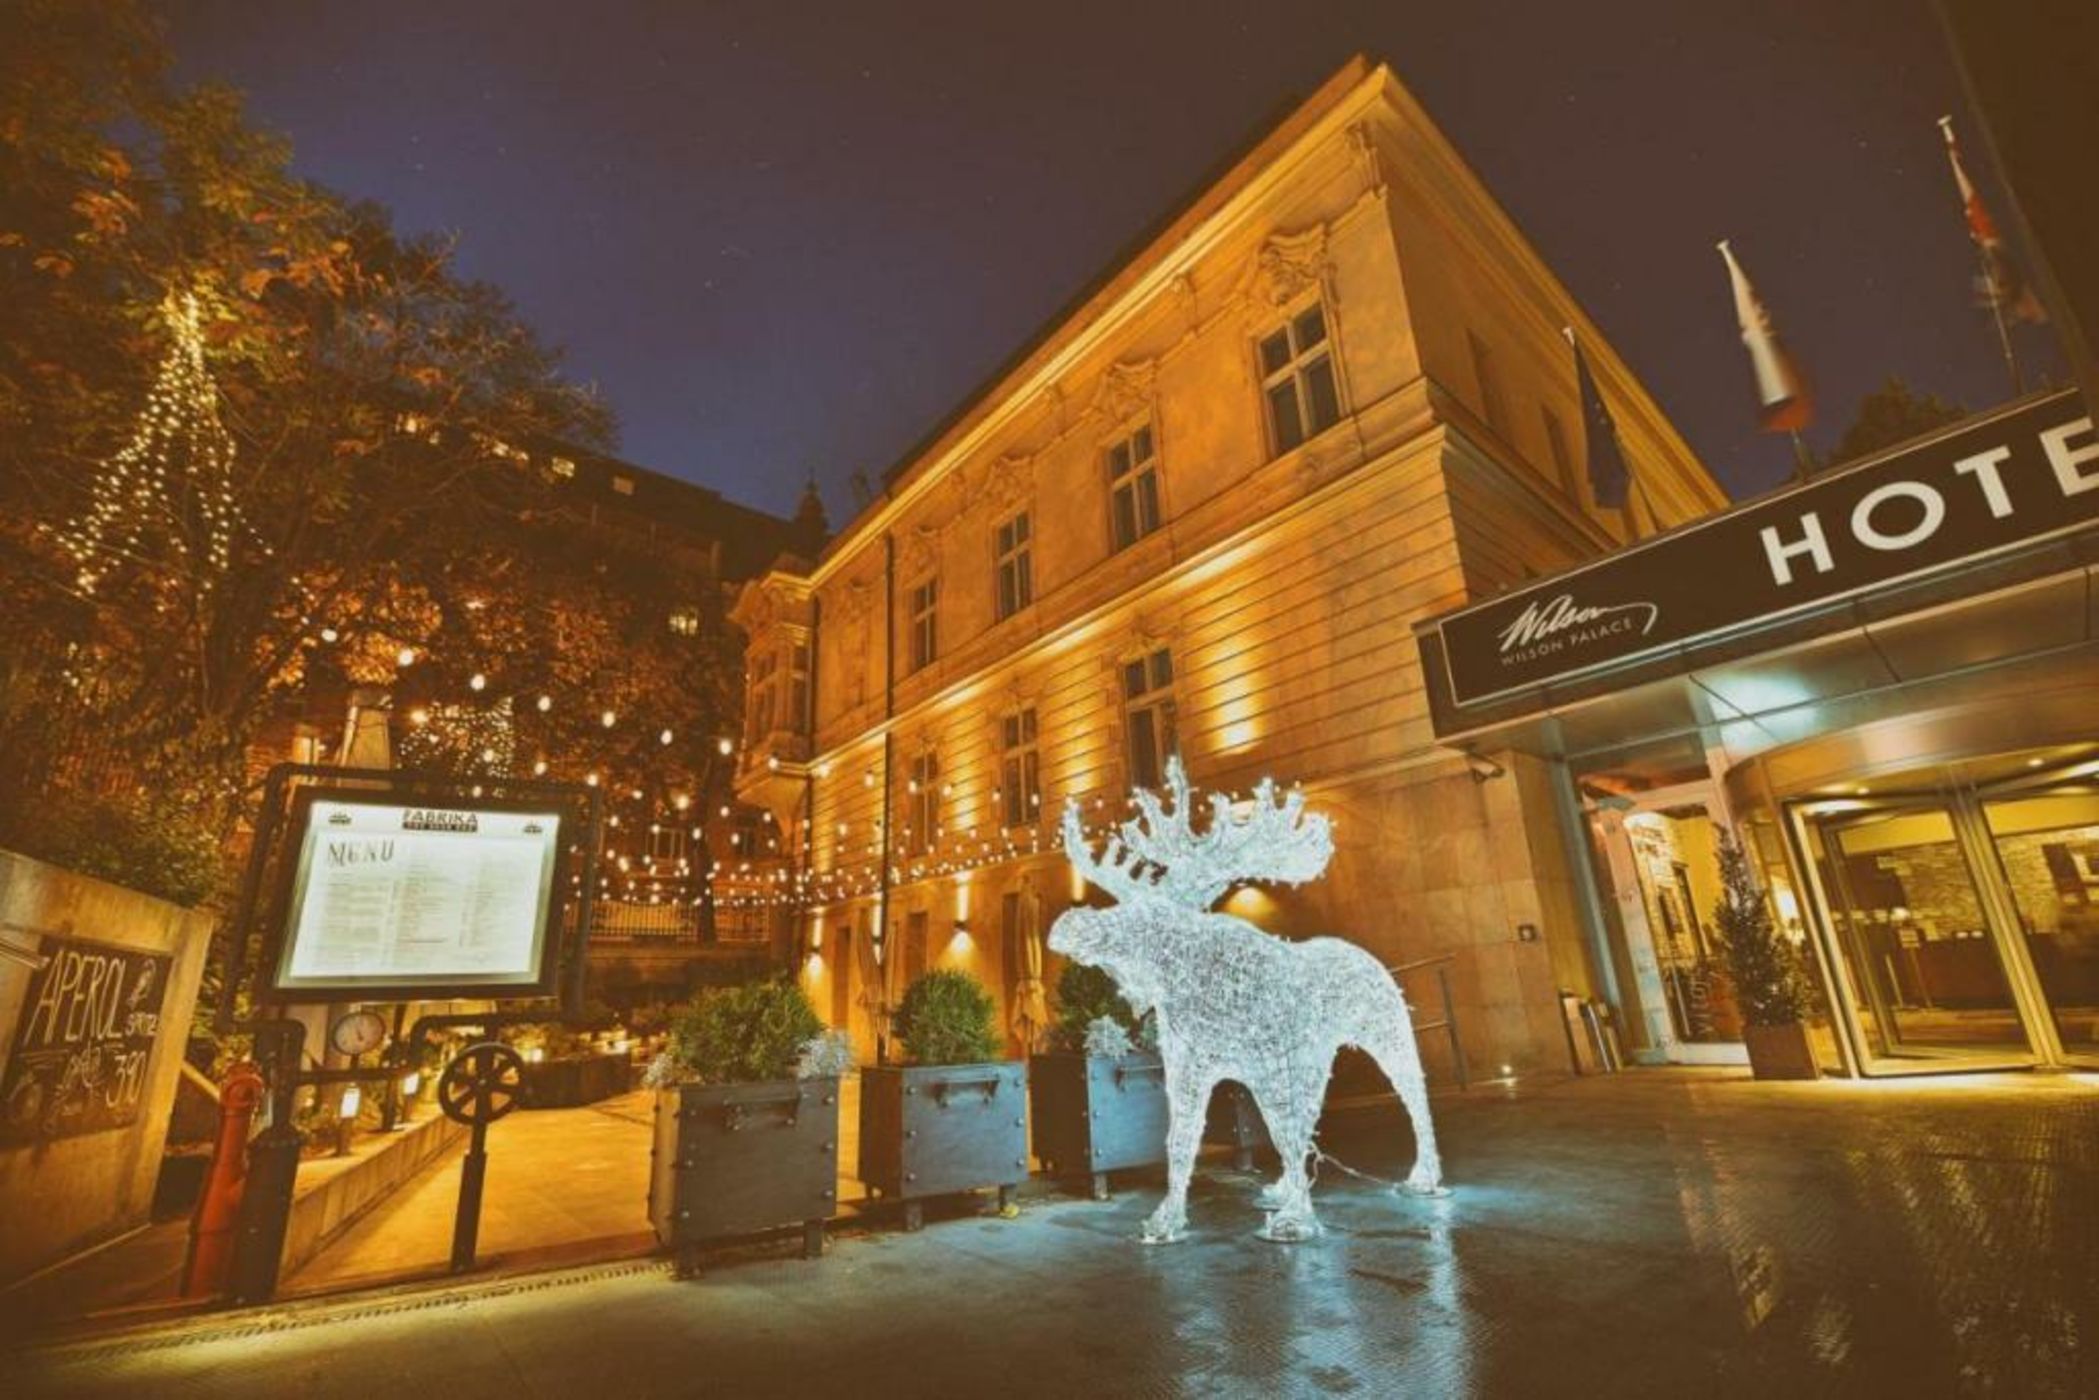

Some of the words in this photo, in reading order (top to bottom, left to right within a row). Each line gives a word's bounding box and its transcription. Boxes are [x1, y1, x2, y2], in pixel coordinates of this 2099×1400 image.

[1760, 416, 2099, 586] HOTE
[1498, 594, 1657, 651] Wilson
[1501, 640, 1563, 665] WILSON
[1569, 616, 1632, 645] PALACE
[402, 808, 478, 824] FABRIKA
[328, 838, 395, 867] MENU
[22, 948, 127, 1047] APEROL
